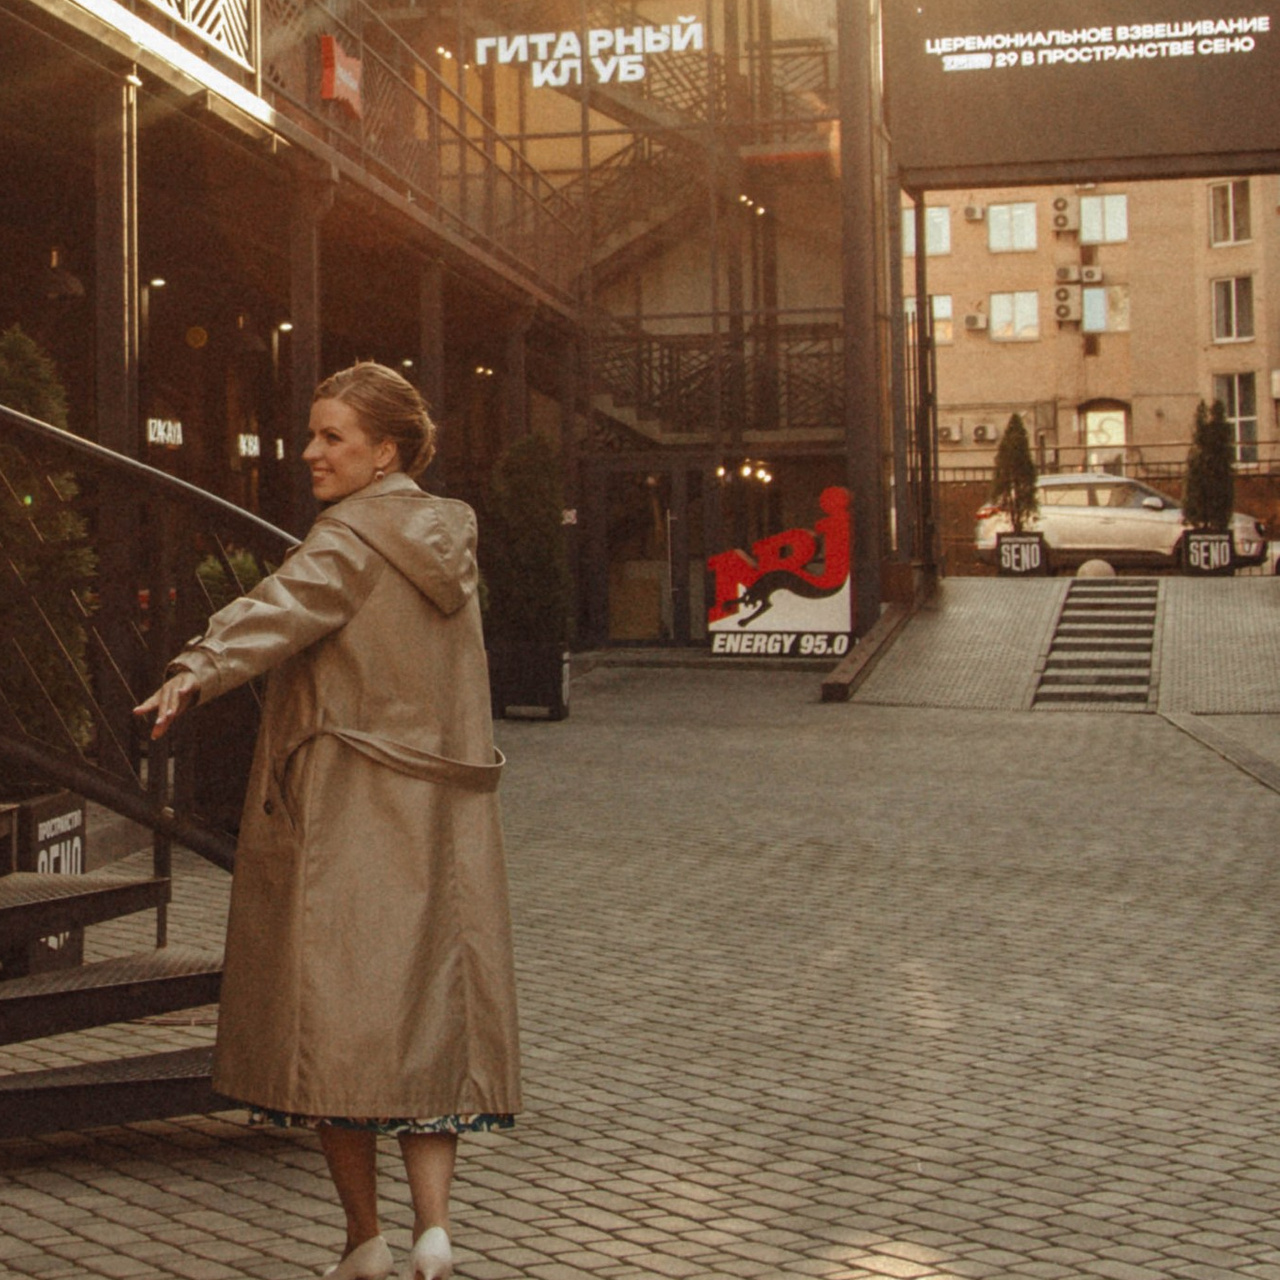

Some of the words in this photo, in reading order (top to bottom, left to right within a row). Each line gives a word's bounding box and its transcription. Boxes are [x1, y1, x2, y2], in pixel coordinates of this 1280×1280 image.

[476, 15, 703, 65] ГИТАРНЫЙ
[925, 27, 1113, 55] ЦЕРЕМОНИАЛЬНОЕ
[1116, 16, 1270, 41] ВЗВЕШИВАНИЕ
[995, 52, 1018, 68] 29
[1021, 51, 1035, 66] В
[1038, 40, 1195, 64] ПРОСТРАНСТВЕ
[1198, 36, 1256, 54] СЕНО
[532, 55, 645, 88] КЛУБ
[1001, 543, 1041, 572] SENO
[1189, 541, 1230, 570] SENO
[712, 634, 797, 654] ENERGY
[799, 634, 849, 655] 95.0
